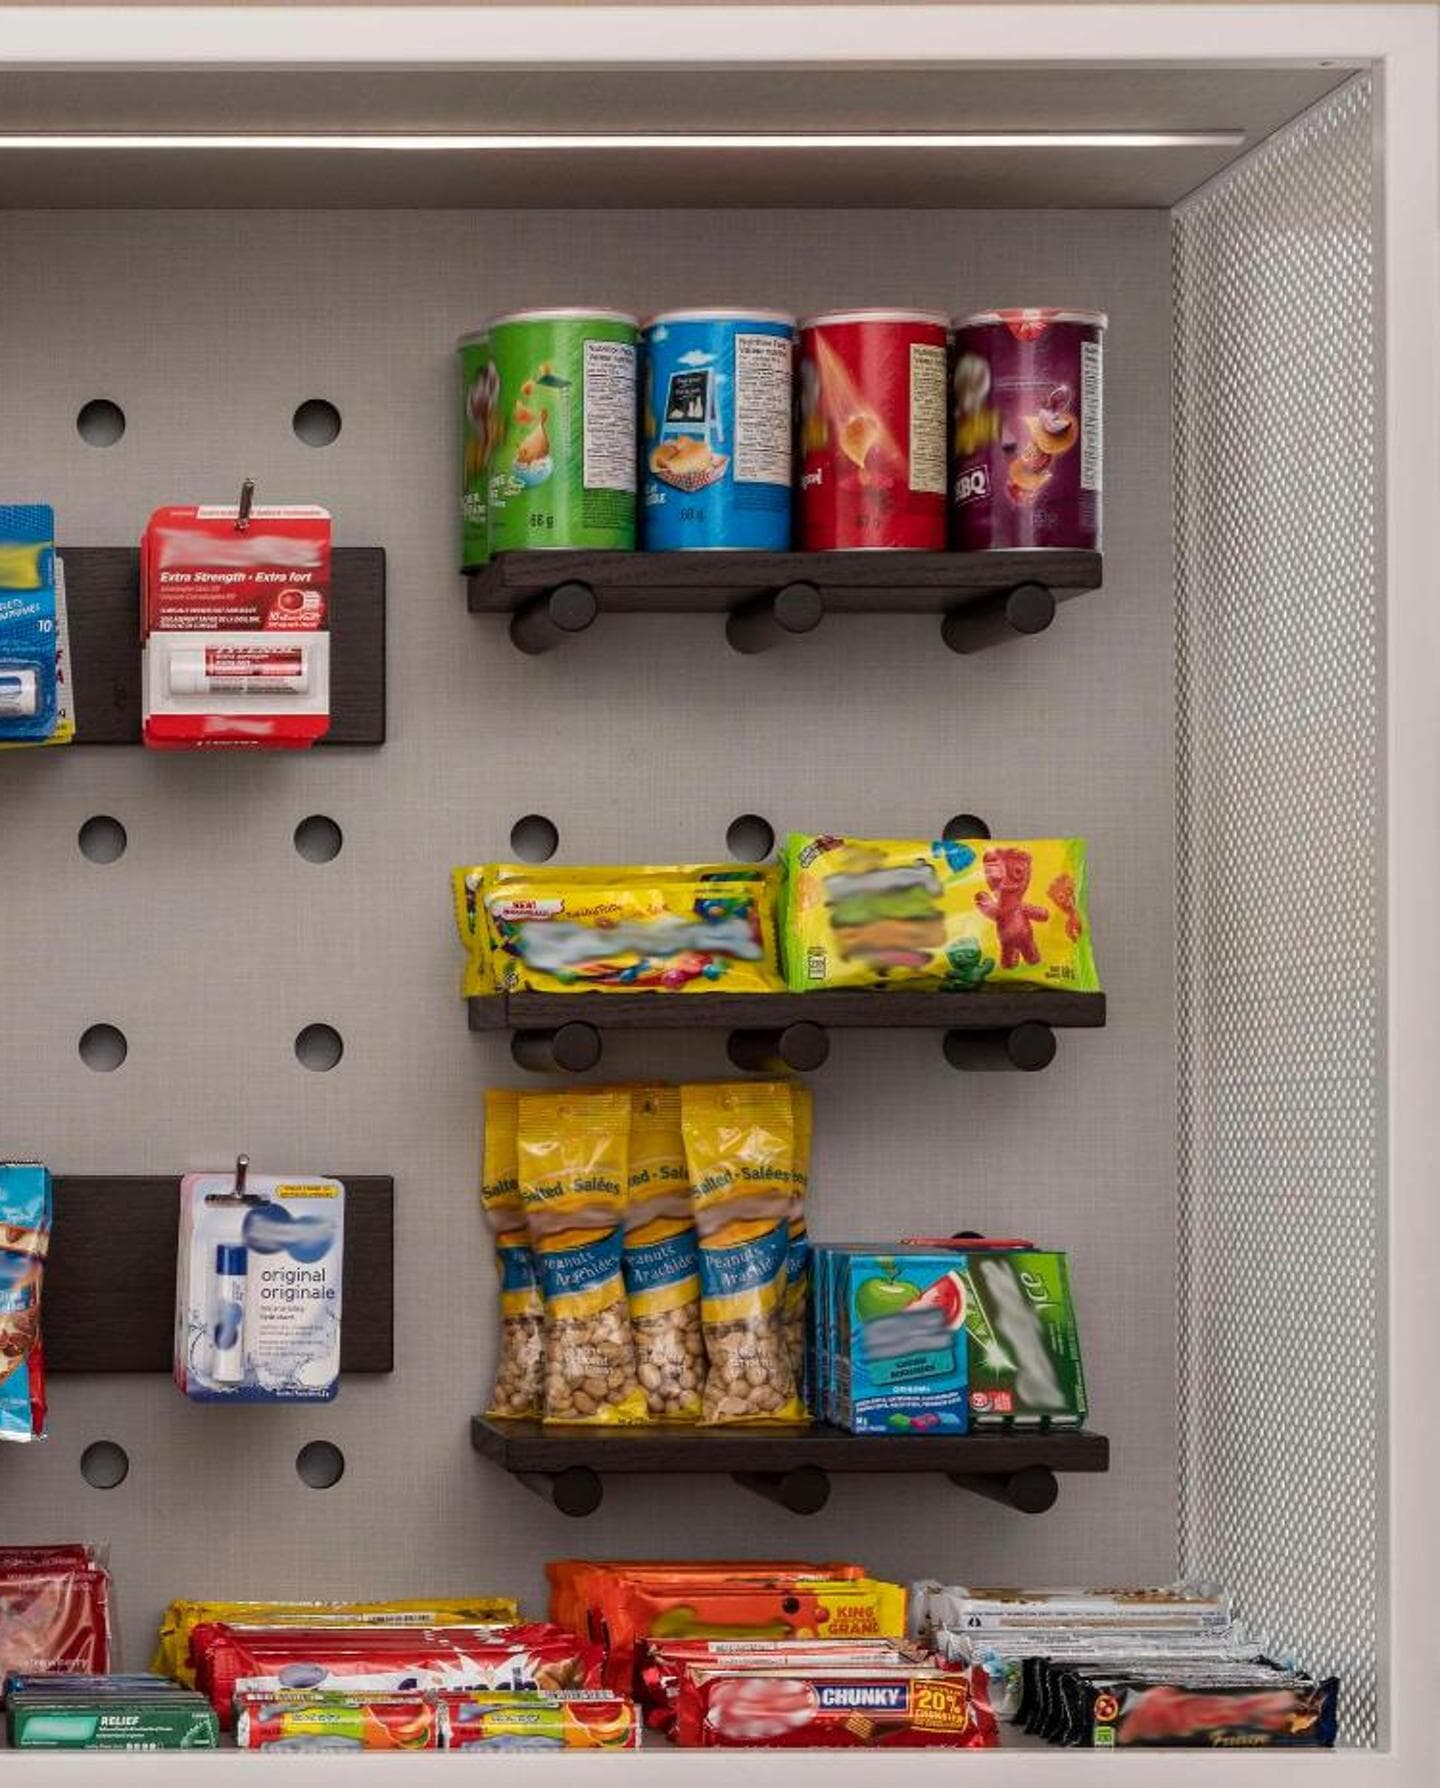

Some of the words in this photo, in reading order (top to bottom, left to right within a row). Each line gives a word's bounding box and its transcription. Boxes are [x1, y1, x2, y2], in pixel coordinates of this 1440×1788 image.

[160, 572, 191, 583] Extra
[193, 571, 245, 584] Strength
[255, 572, 287, 583] Extra
[38, 619, 53, 633] 10
[261, 1267, 326, 1285] original
[260, 1286, 336, 1302] originale
[836, 1606, 876, 1618] KING
[828, 1622, 880, 1635] GRAND
[821, 1687, 900, 1706] CHUNKY
[917, 1690, 961, 1714] 20%
[101, 1716, 140, 1726] RELIEF
